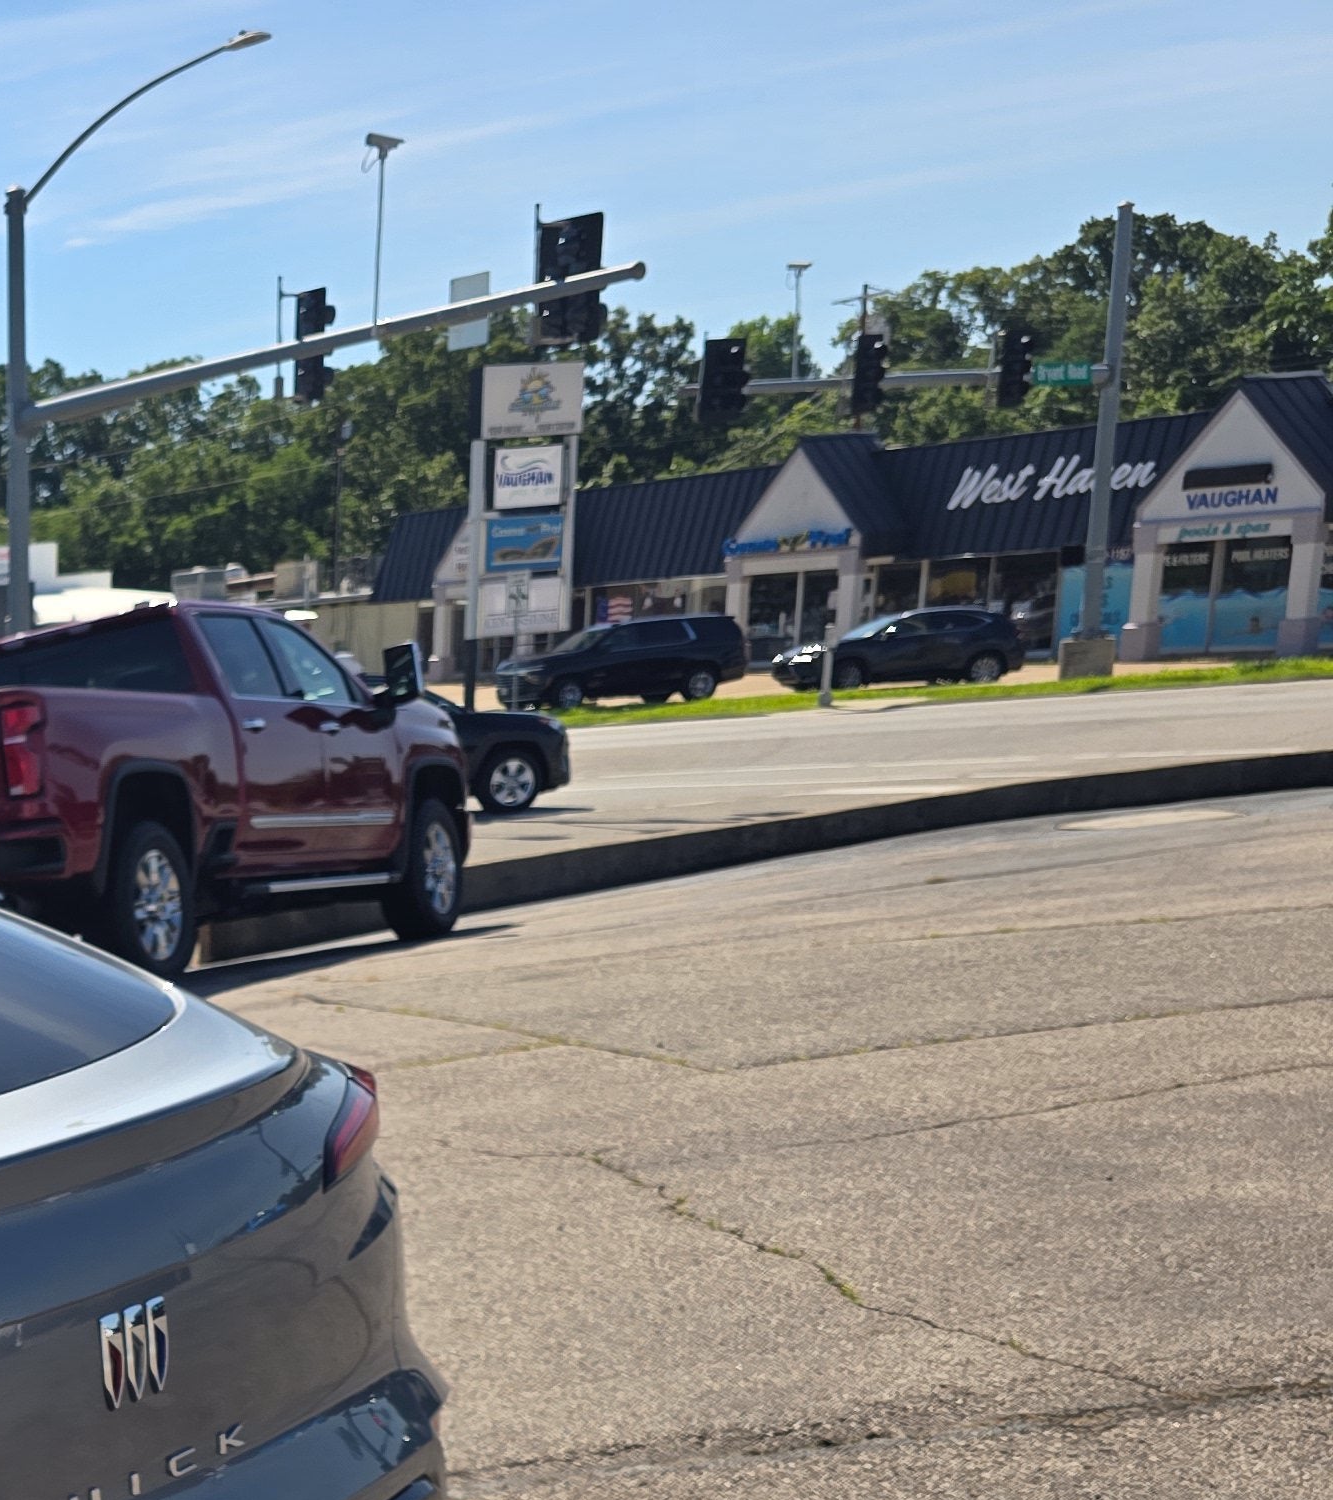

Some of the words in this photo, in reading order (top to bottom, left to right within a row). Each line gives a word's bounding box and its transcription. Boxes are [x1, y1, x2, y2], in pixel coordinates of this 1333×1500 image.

[496, 470, 553, 488] VAUGHAN
[947, 463, 1035, 510] West
[1033, 454, 1158, 501] Haen
[1186, 487, 1278, 510] VAUGHAN
[1178, 523, 1218, 541] pools
[1236, 522, 1271, 538] spas
